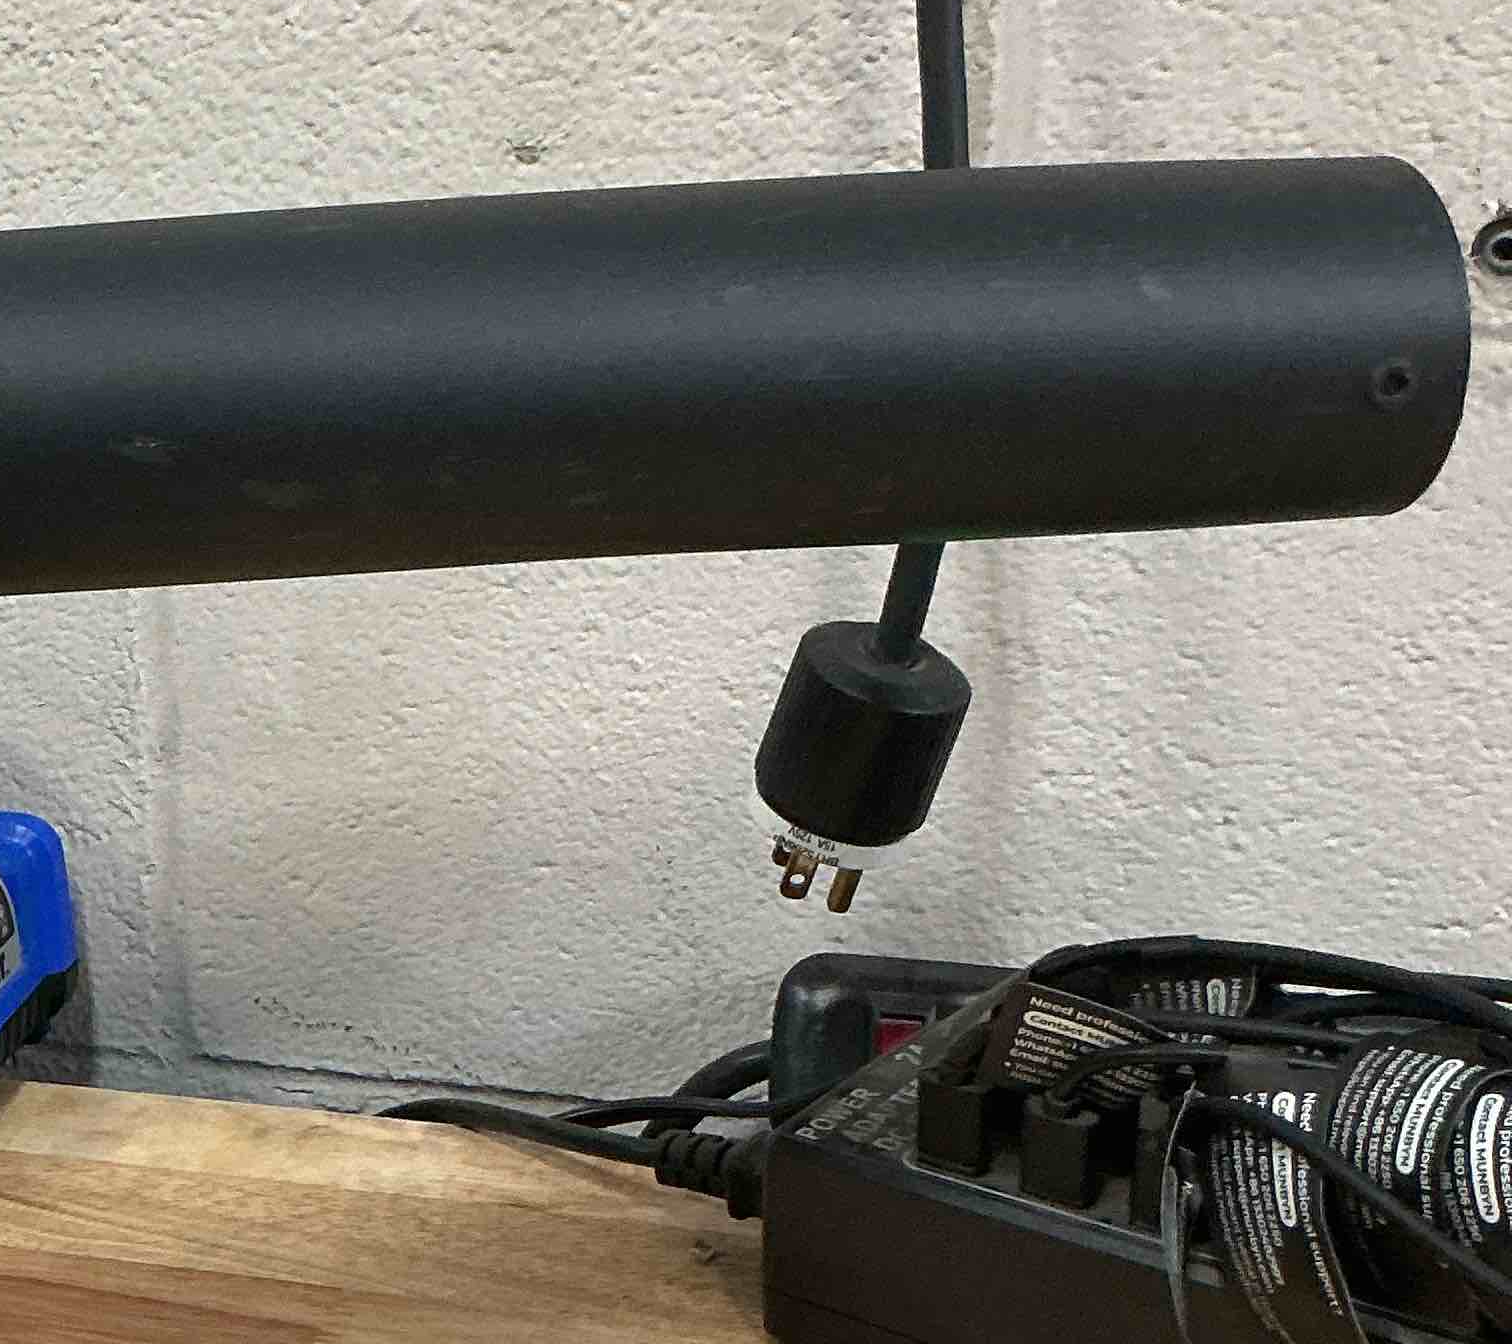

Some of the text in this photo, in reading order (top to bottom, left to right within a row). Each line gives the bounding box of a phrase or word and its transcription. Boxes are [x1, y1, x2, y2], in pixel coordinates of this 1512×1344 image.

[1029, 995, 1074, 1017] Need
[793, 1088, 881, 1142] POWER
[1401, 1103, 1426, 1167] MUNBYN
[1420, 1090, 1455, 1191] professional
[1476, 1097, 1497, 1217] Contact MUNBYN
